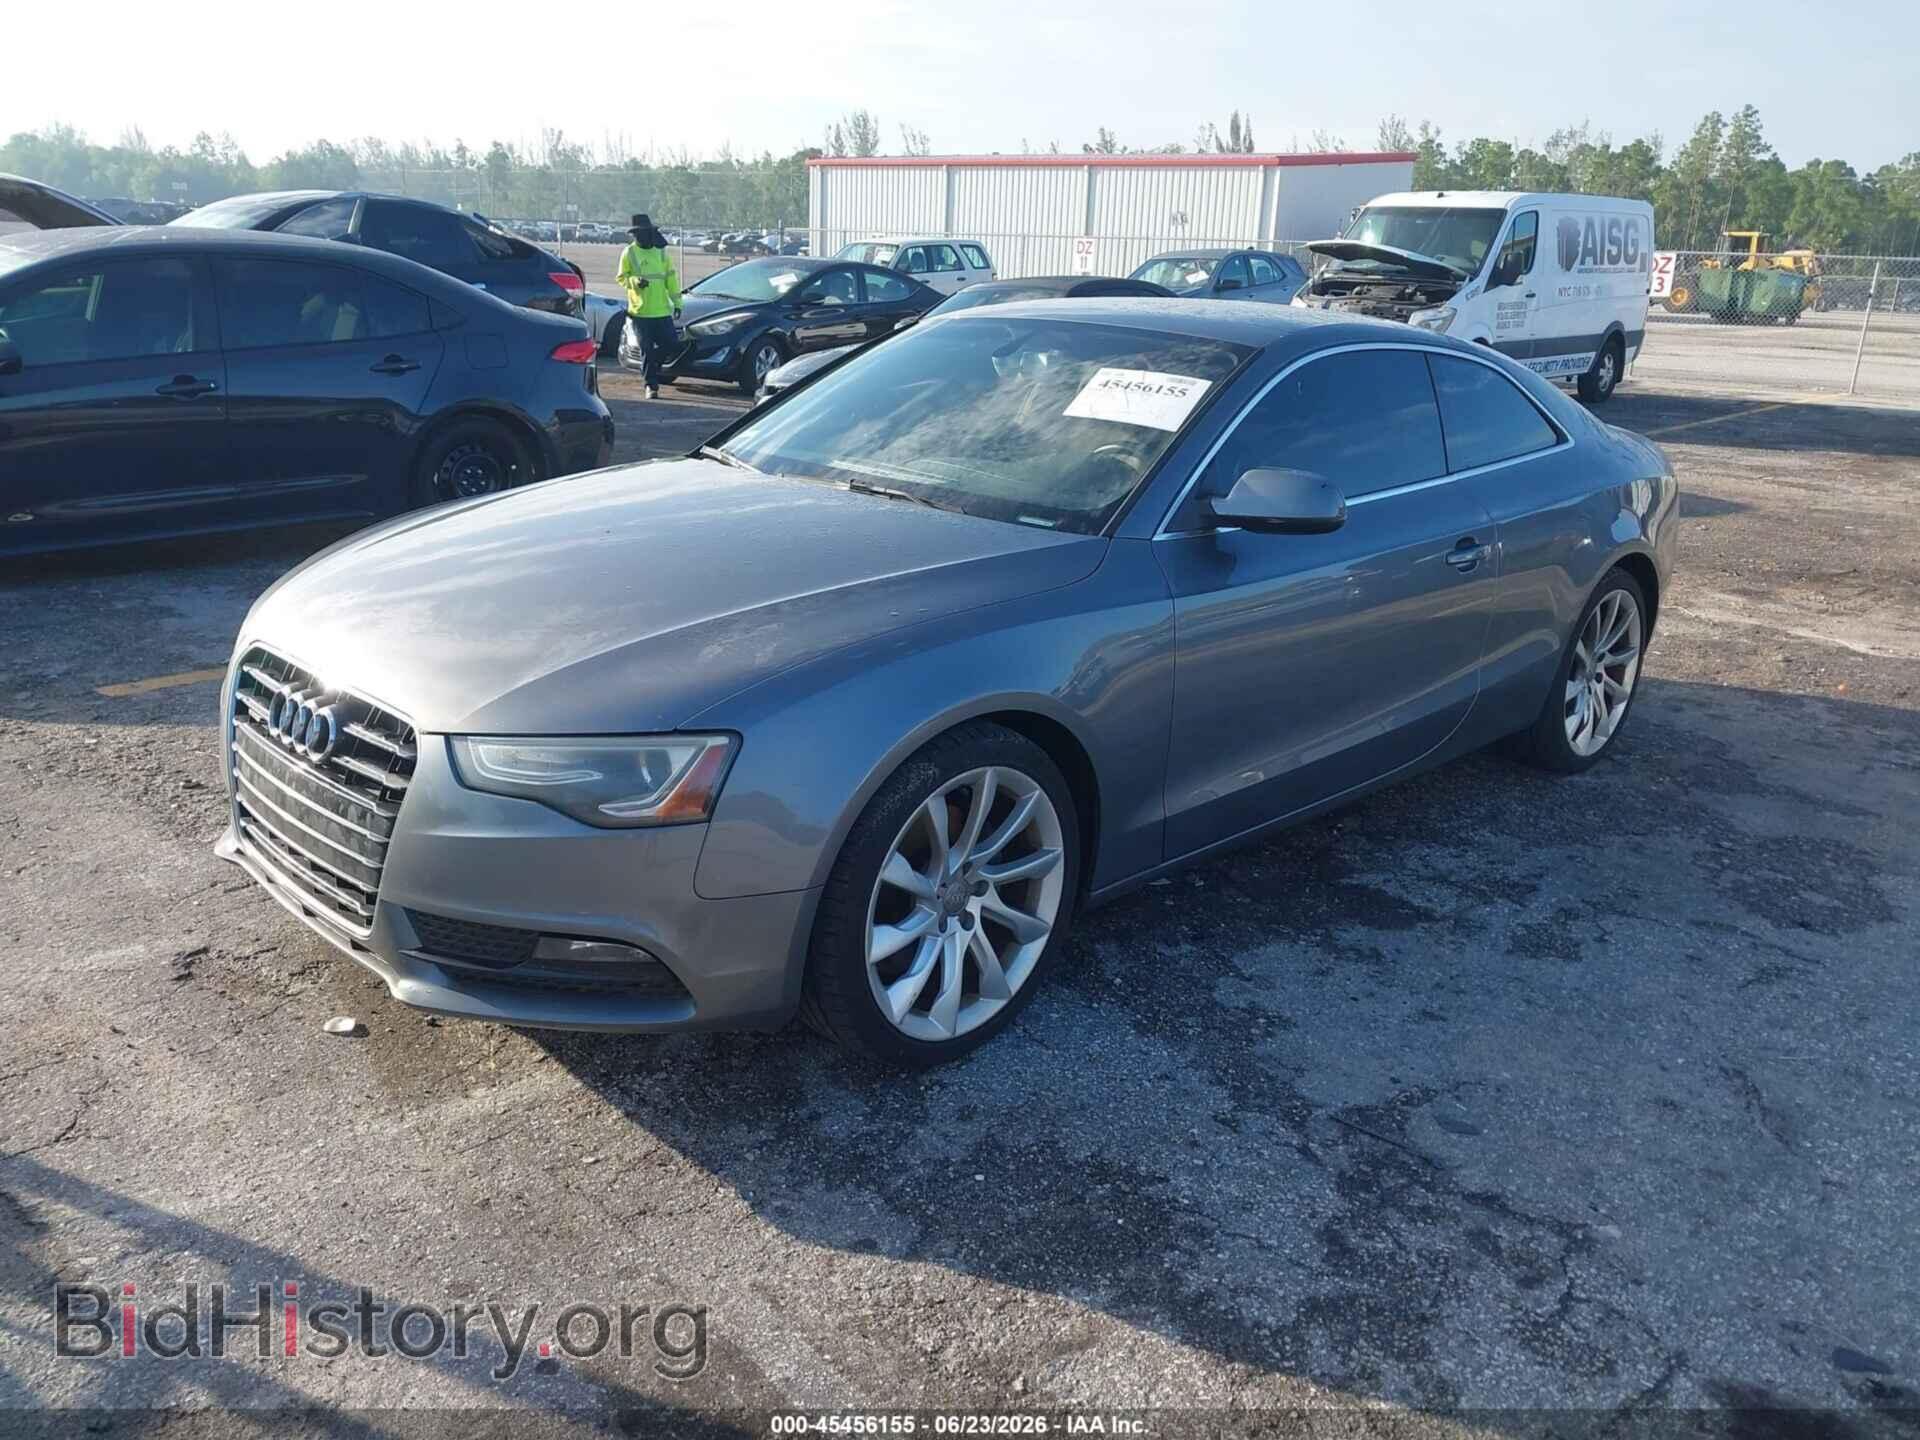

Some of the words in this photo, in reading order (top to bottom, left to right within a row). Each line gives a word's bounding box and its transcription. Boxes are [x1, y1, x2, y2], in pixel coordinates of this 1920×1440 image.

[1077, 240, 1093, 254] DZ
[1579, 216, 1639, 266] AISG
[1654, 276, 1665, 293] 3
[1098, 379, 1189, 398] 45456155
